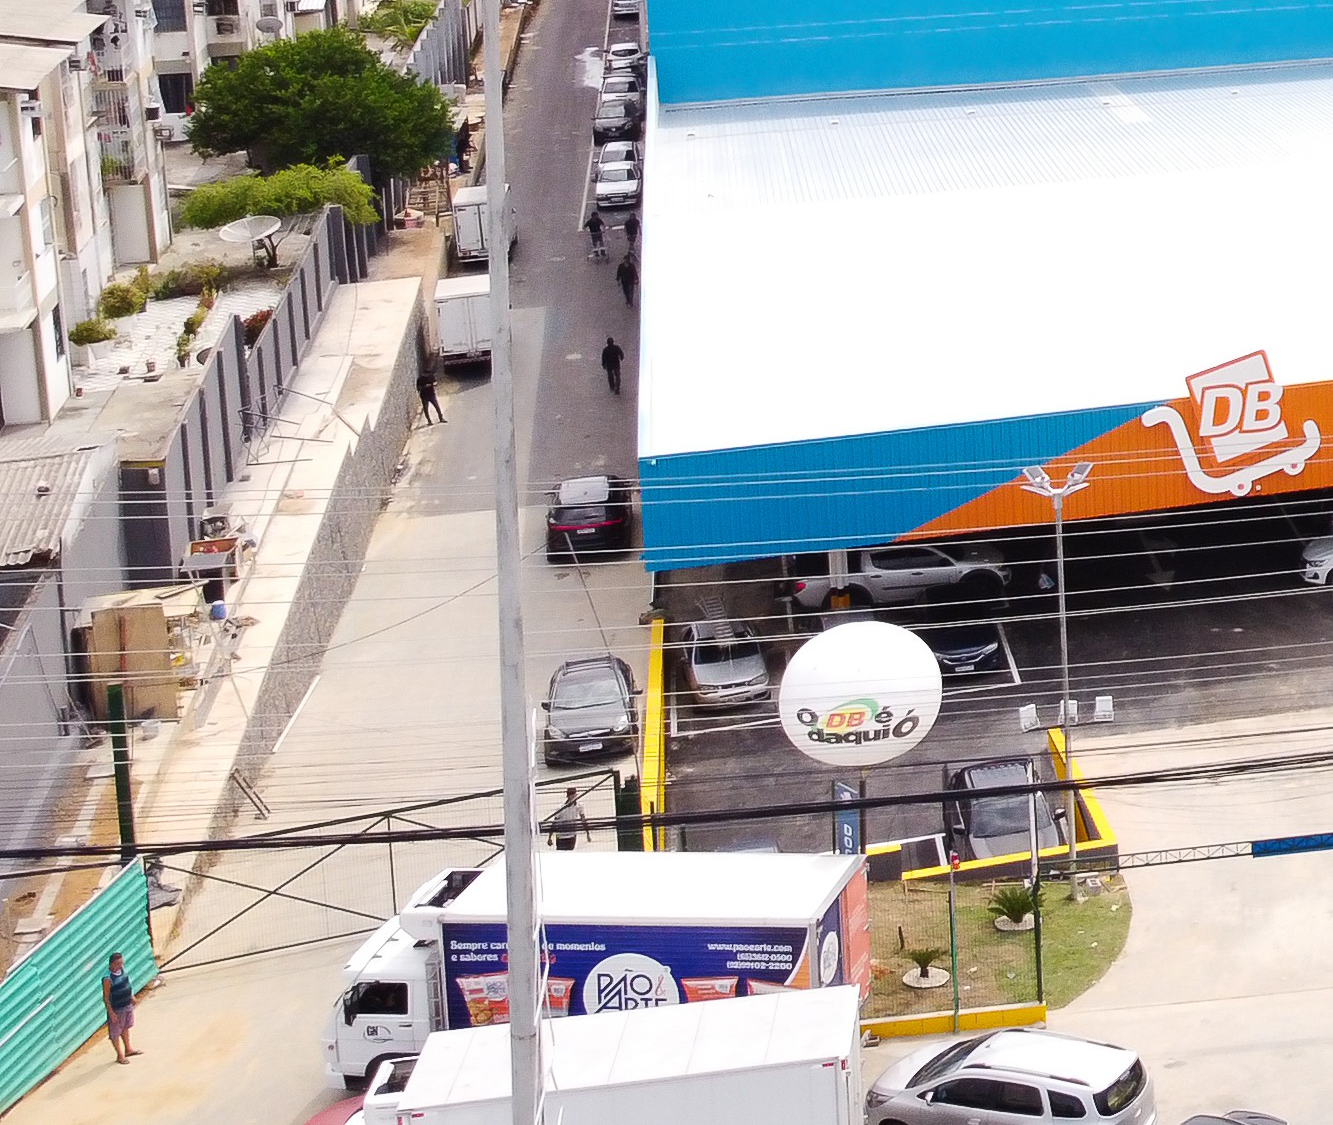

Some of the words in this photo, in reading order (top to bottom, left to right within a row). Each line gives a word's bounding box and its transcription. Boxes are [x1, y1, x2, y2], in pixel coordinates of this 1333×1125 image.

[1200, 382, 1285, 437] DB
[797, 707, 819, 726] O
[826, 711, 866, 728] DB
[875, 706, 895, 724] é
[808, 724, 890, 744] daqui
[450, 940, 489, 951] Sempre
[556, 942, 607, 951] momentos
[451, 953, 458, 962] e
[459, 952, 499, 962] sabores
